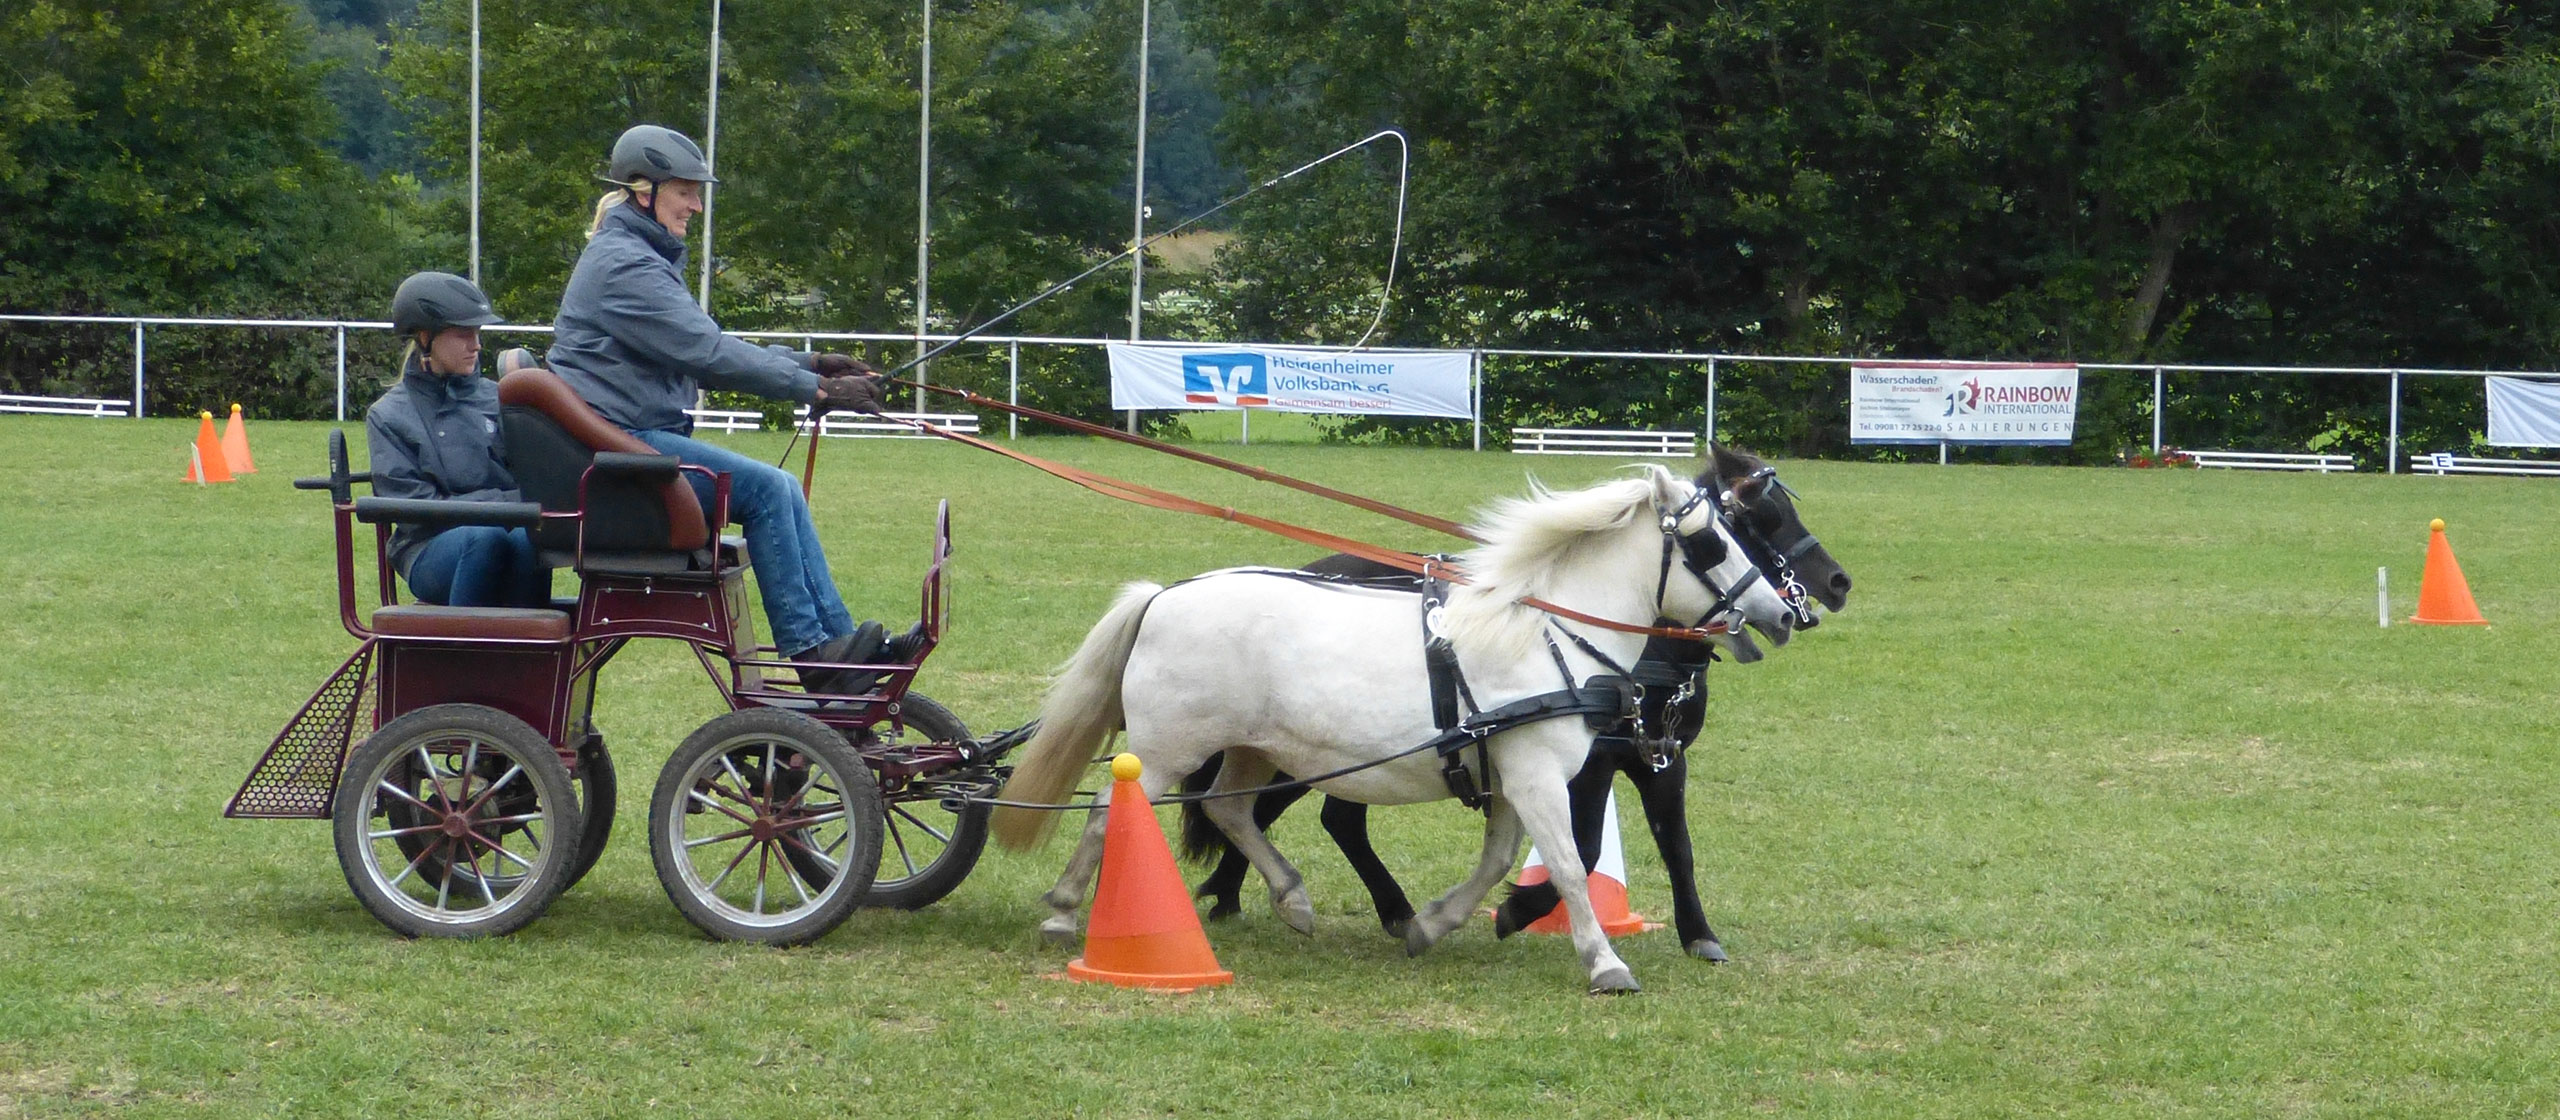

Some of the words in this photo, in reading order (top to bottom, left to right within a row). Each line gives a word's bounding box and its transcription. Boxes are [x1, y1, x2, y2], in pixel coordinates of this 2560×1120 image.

[1273, 376, 1362, 392] Volksbank
[1859, 374, 1938, 385] Wasserschaden?
[1891, 385, 1943, 393] Brandschaden?
[1984, 386, 2072, 403] RAINBOW
[1274, 398, 1346, 409] Gemeinsam
[1984, 404, 2071, 415] INTERNATIONAL
[1859, 423, 1872, 431] Tel.
[1947, 422, 2071, 432] SANIERUNGEN
[2436, 455, 2450, 468] E
